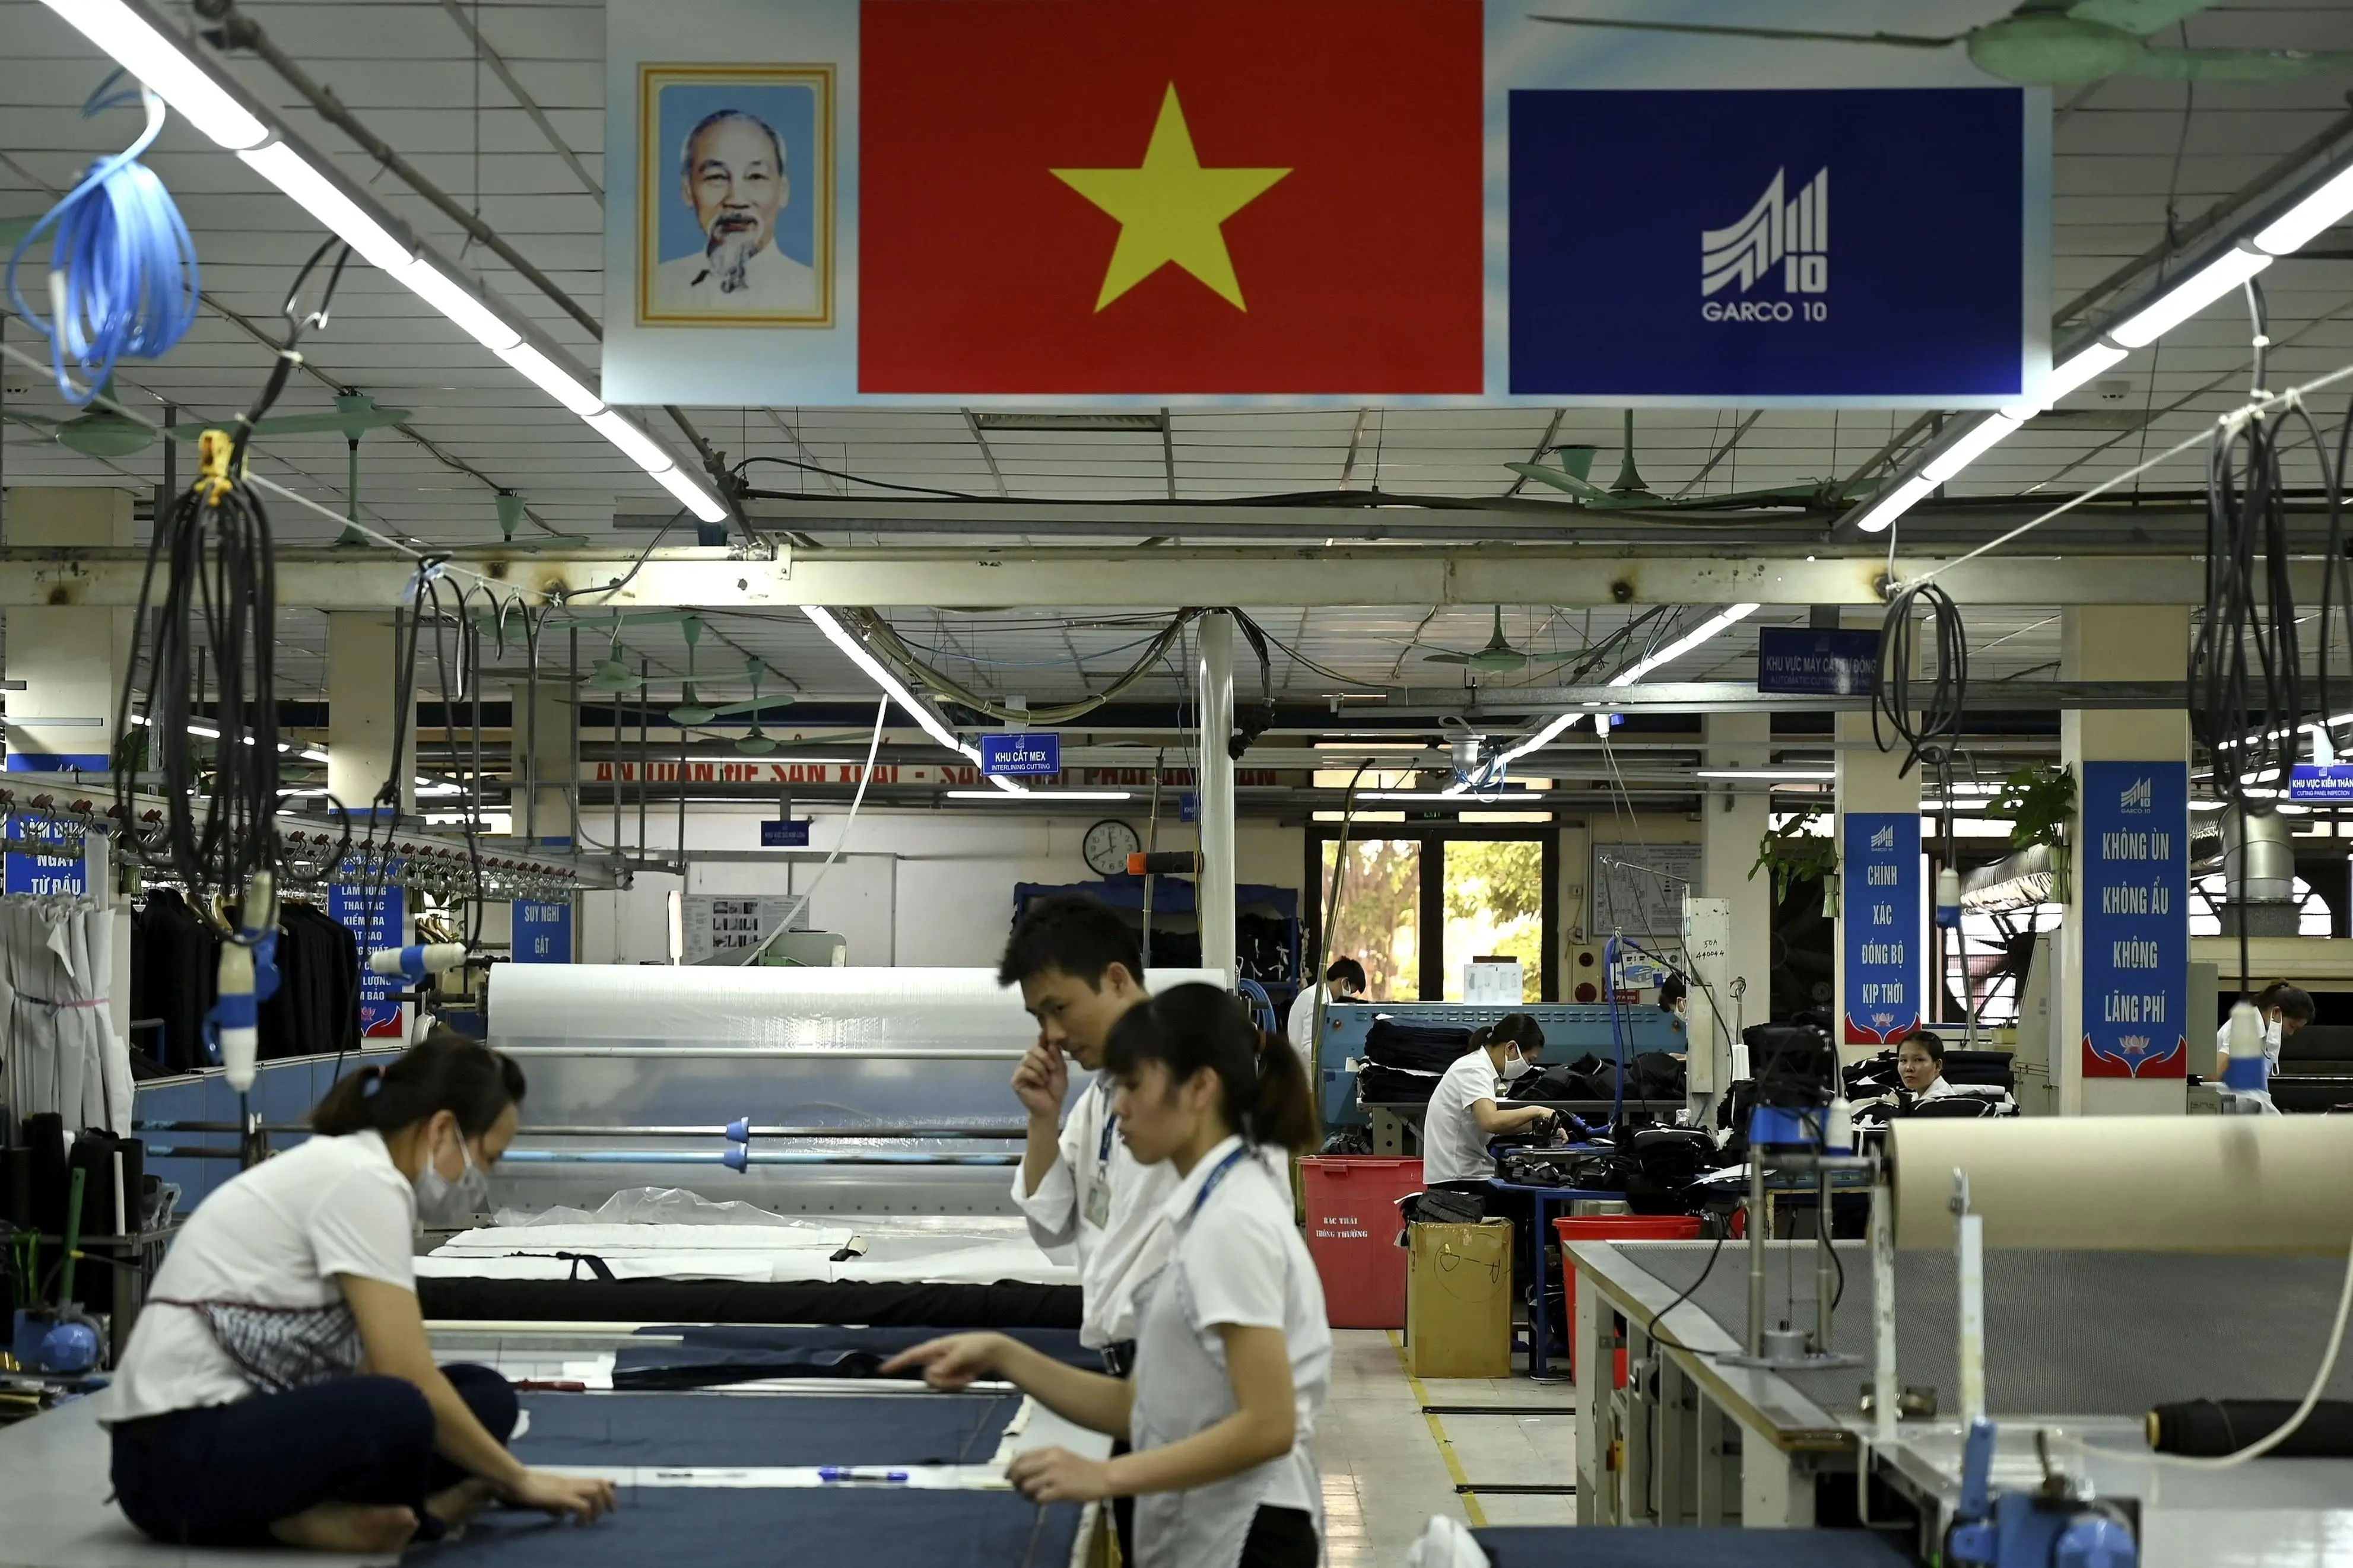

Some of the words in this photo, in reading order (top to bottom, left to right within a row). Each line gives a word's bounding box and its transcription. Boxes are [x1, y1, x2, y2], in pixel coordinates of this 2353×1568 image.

[1701, 301, 1793, 322] GARCO
[1802, 301, 1828, 322] 10
[1766, 656, 1783, 671] KHU
[1785, 655, 1802, 675] VỰC
[1804, 654, 1821, 672] MÁY
[995, 752, 1011, 762] KHU
[1013, 748, 1028, 762] CẮT
[1030, 751, 1046, 762] MEX
[2292, 779, 2305, 788] KHU
[2306, 778, 2320, 790] VỰC
[2321, 775, 2336, 788] KIỂM
[2103, 827, 2147, 860] KHÔNG
[2151, 827, 2169, 860] ÙN
[31, 874, 50, 895] TỪ
[52, 873, 81, 895] ĐẦU
[1868, 861, 1897, 885] CHÍNH
[2103, 881, 2147, 914] KHÔNG
[2151, 876, 2168, 914] ẨU
[344, 913, 365, 925] KIỂM
[525, 905, 539, 922] SUY
[1873, 901, 1892, 925] XÁC
[1862, 937, 1888, 965] ĐỒNG
[1891, 940, 1904, 969] BỘ
[2113, 935, 2157, 968] KHÔNG
[367, 987, 385, 1000] BẢO
[1863, 984, 1879, 1008] KỊP
[1882, 978, 1903, 1004] THỜI
[2105, 990, 2139, 1022] LÃNG
[2143, 990, 2165, 1023] PHÍ
